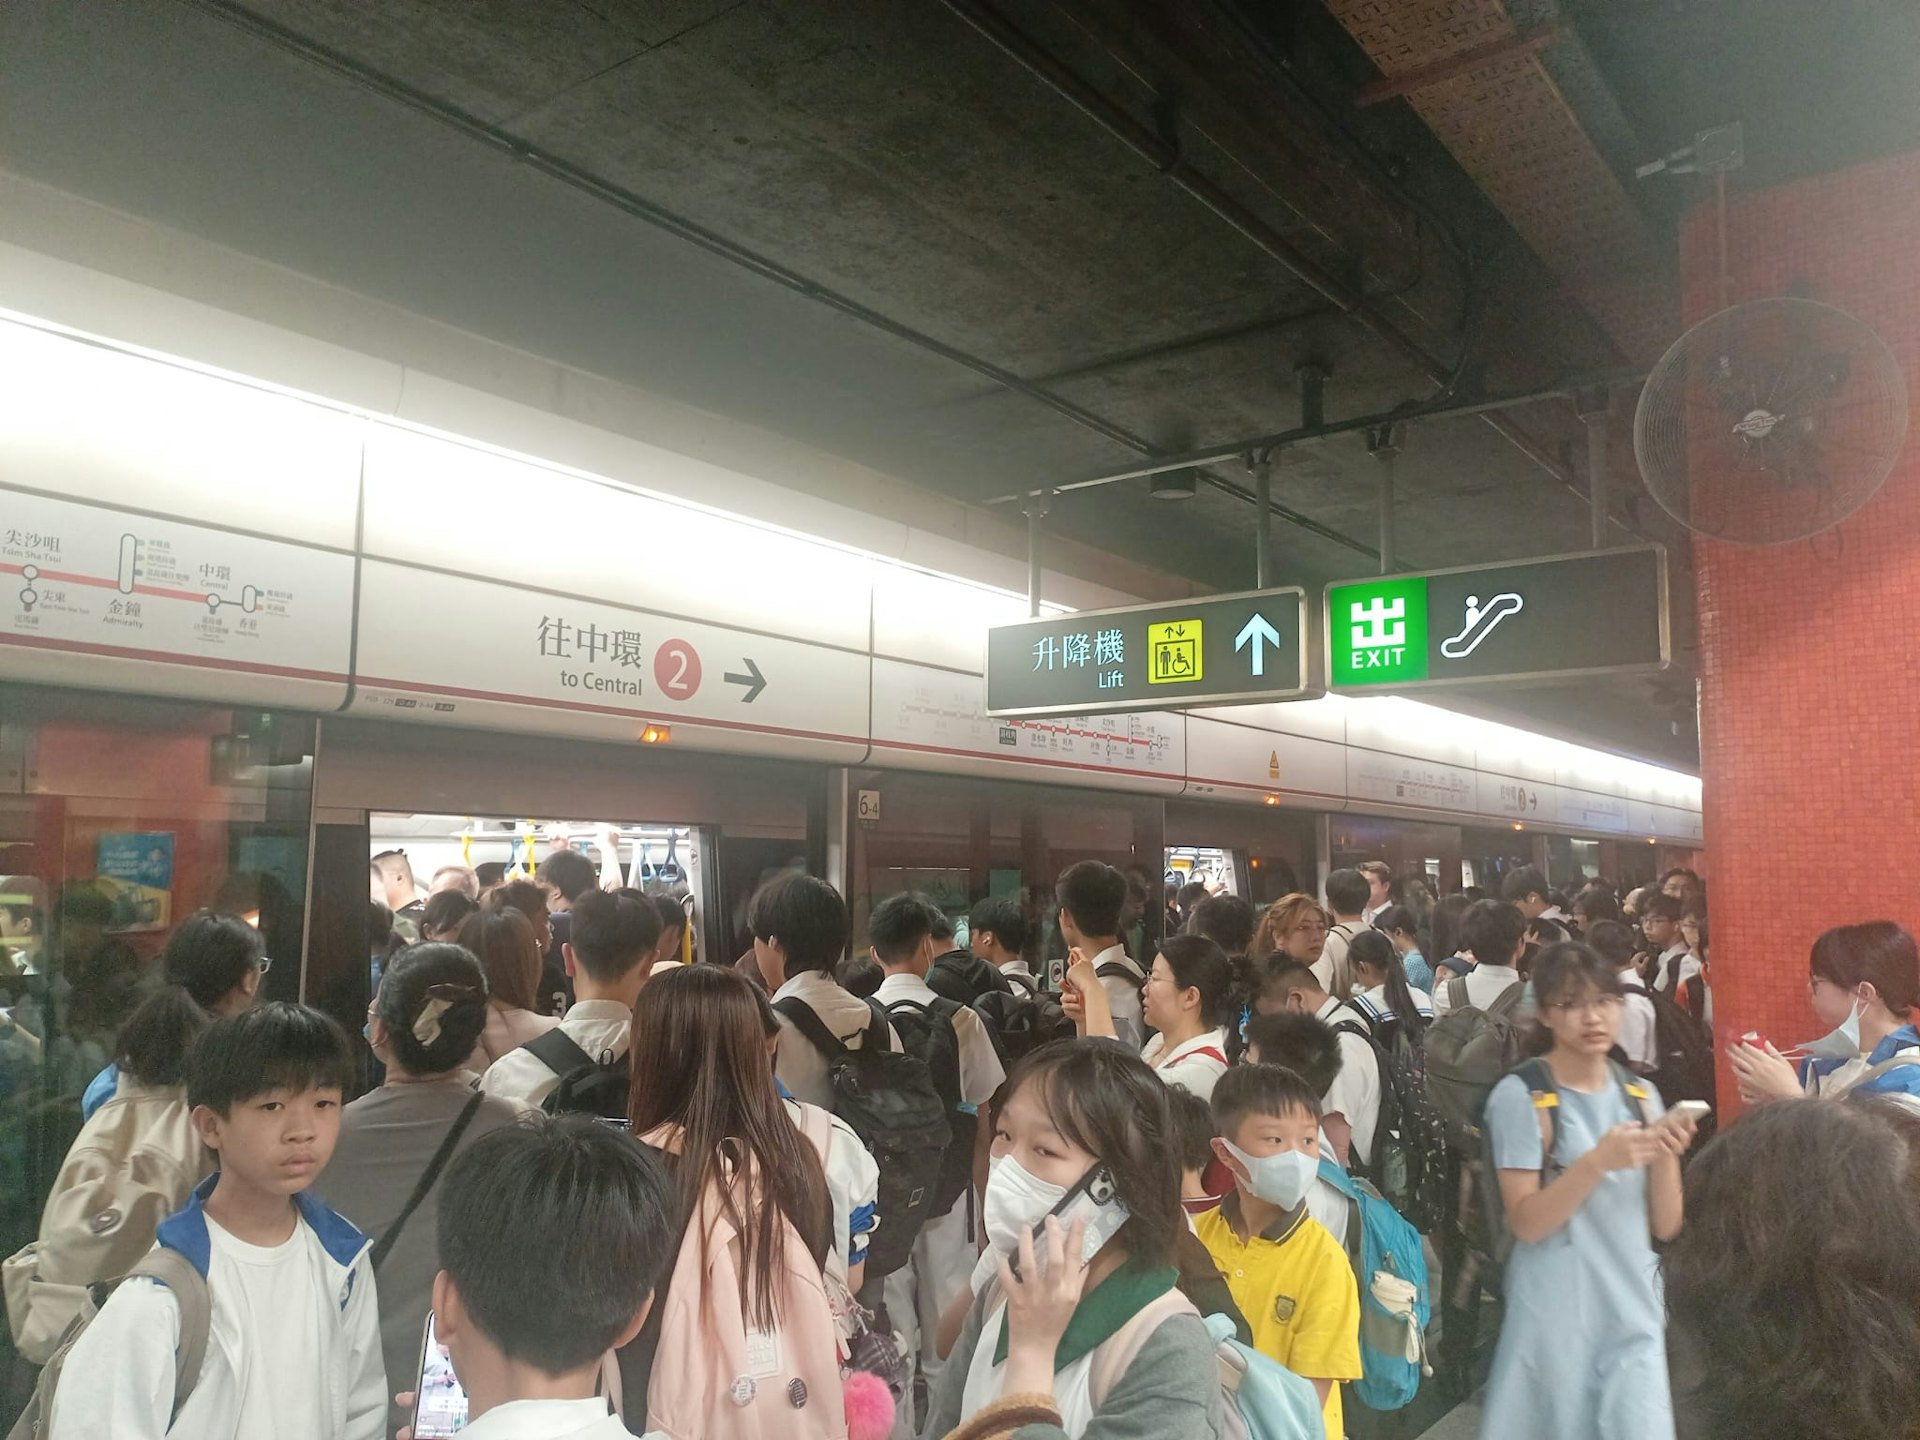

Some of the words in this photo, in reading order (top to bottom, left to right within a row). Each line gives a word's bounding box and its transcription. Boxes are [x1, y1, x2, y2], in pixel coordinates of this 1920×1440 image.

[6, 529, 60, 552] 尖沙咀
[2, 548, 23, 557] Tsim
[25, 551, 42, 560] Sha
[44, 553, 61, 563] Tsui
[200, 563, 231, 580] 中環
[201, 580, 228, 590] Central
[108, 599, 141, 617] 金鐘
[103, 615, 143, 630] Admiralty
[1351, 596, 1405, 649] 出
[537, 615, 642, 670] 往中環
[1032, 629, 1124, 673] 升降機
[1351, 647, 1405, 669] EXIT
[667, 650, 689, 689] 2
[1098, 669, 1124, 688] Lift
[561, 670, 578, 687] to
[583, 672, 642, 696] Central
[859, 794, 878, 815] 6-4
[552, 991, 567, 1018] 3
